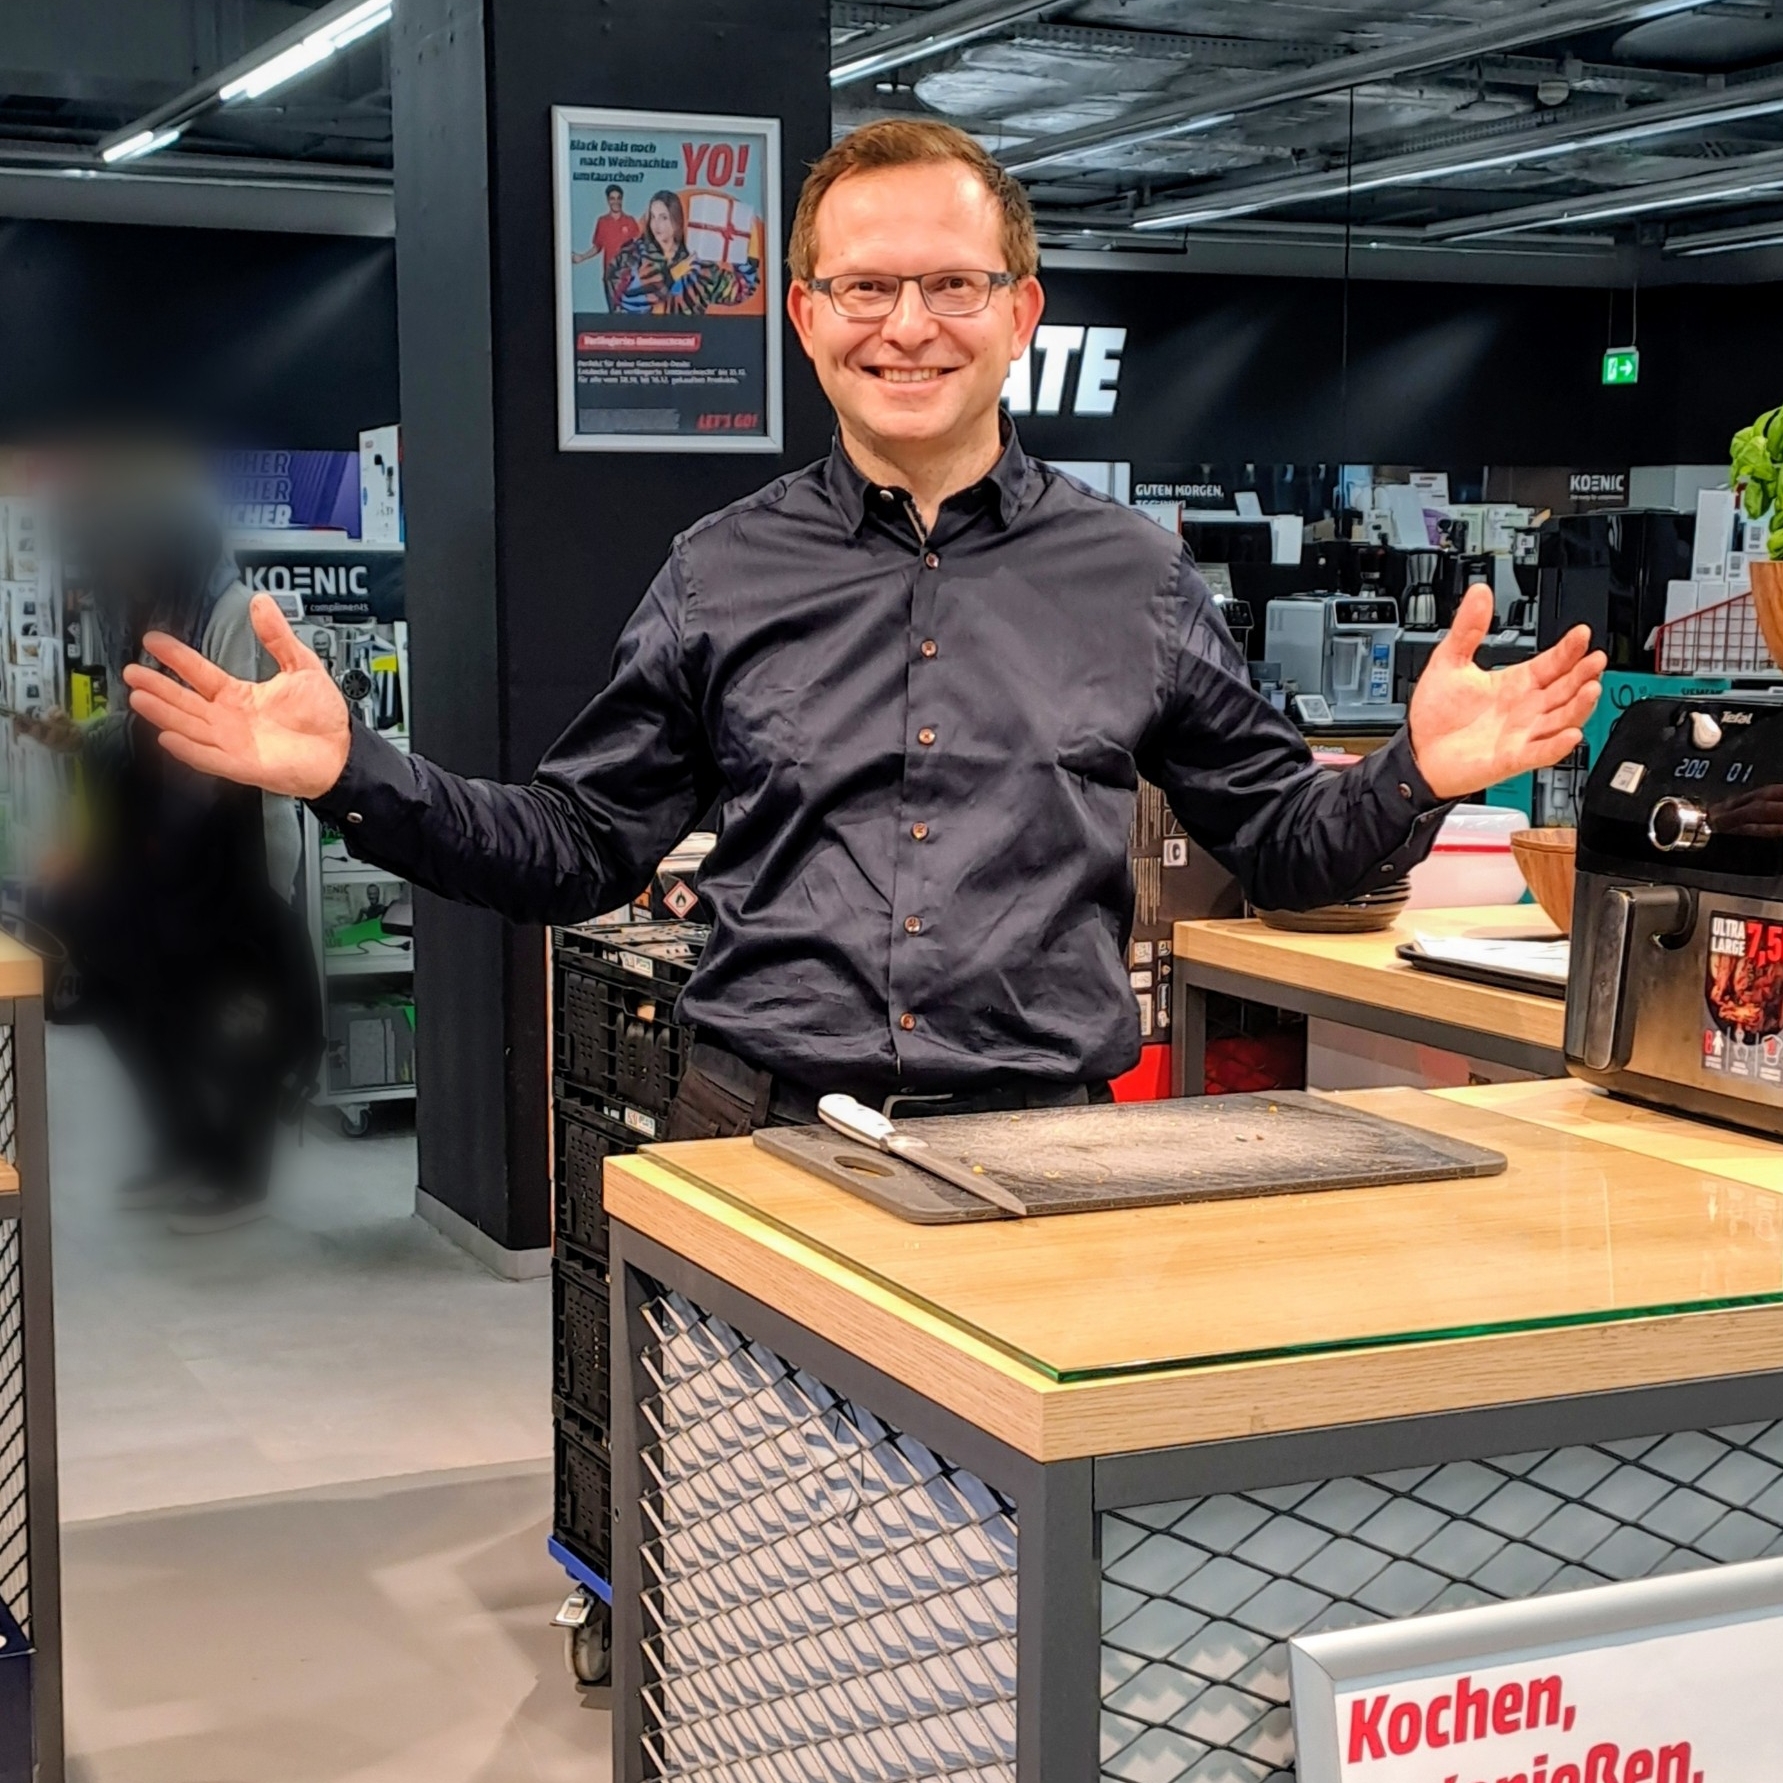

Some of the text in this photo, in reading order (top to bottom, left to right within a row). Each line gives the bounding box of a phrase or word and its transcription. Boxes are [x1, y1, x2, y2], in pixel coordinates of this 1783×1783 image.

[600, 140, 628, 152] Deals
[630, 142, 656, 153] noch
[580, 156, 678, 169] nach Weihnachten
[682, 142, 749, 187] YO!
[573, 172, 644, 183] umtauschen?
[1135, 484, 1224, 499] GUTEN MORGEN,
[1570, 474, 1625, 491] KOENIC
[244, 566, 368, 595] KOENIC
[1720, 711, 1752, 725] Tefal
[1674, 758, 1710, 779] 200
[1713, 917, 1746, 940] ULTRA
[1711, 936, 1746, 958] LARGE
[1347, 1674, 1576, 1763] Kochen,
